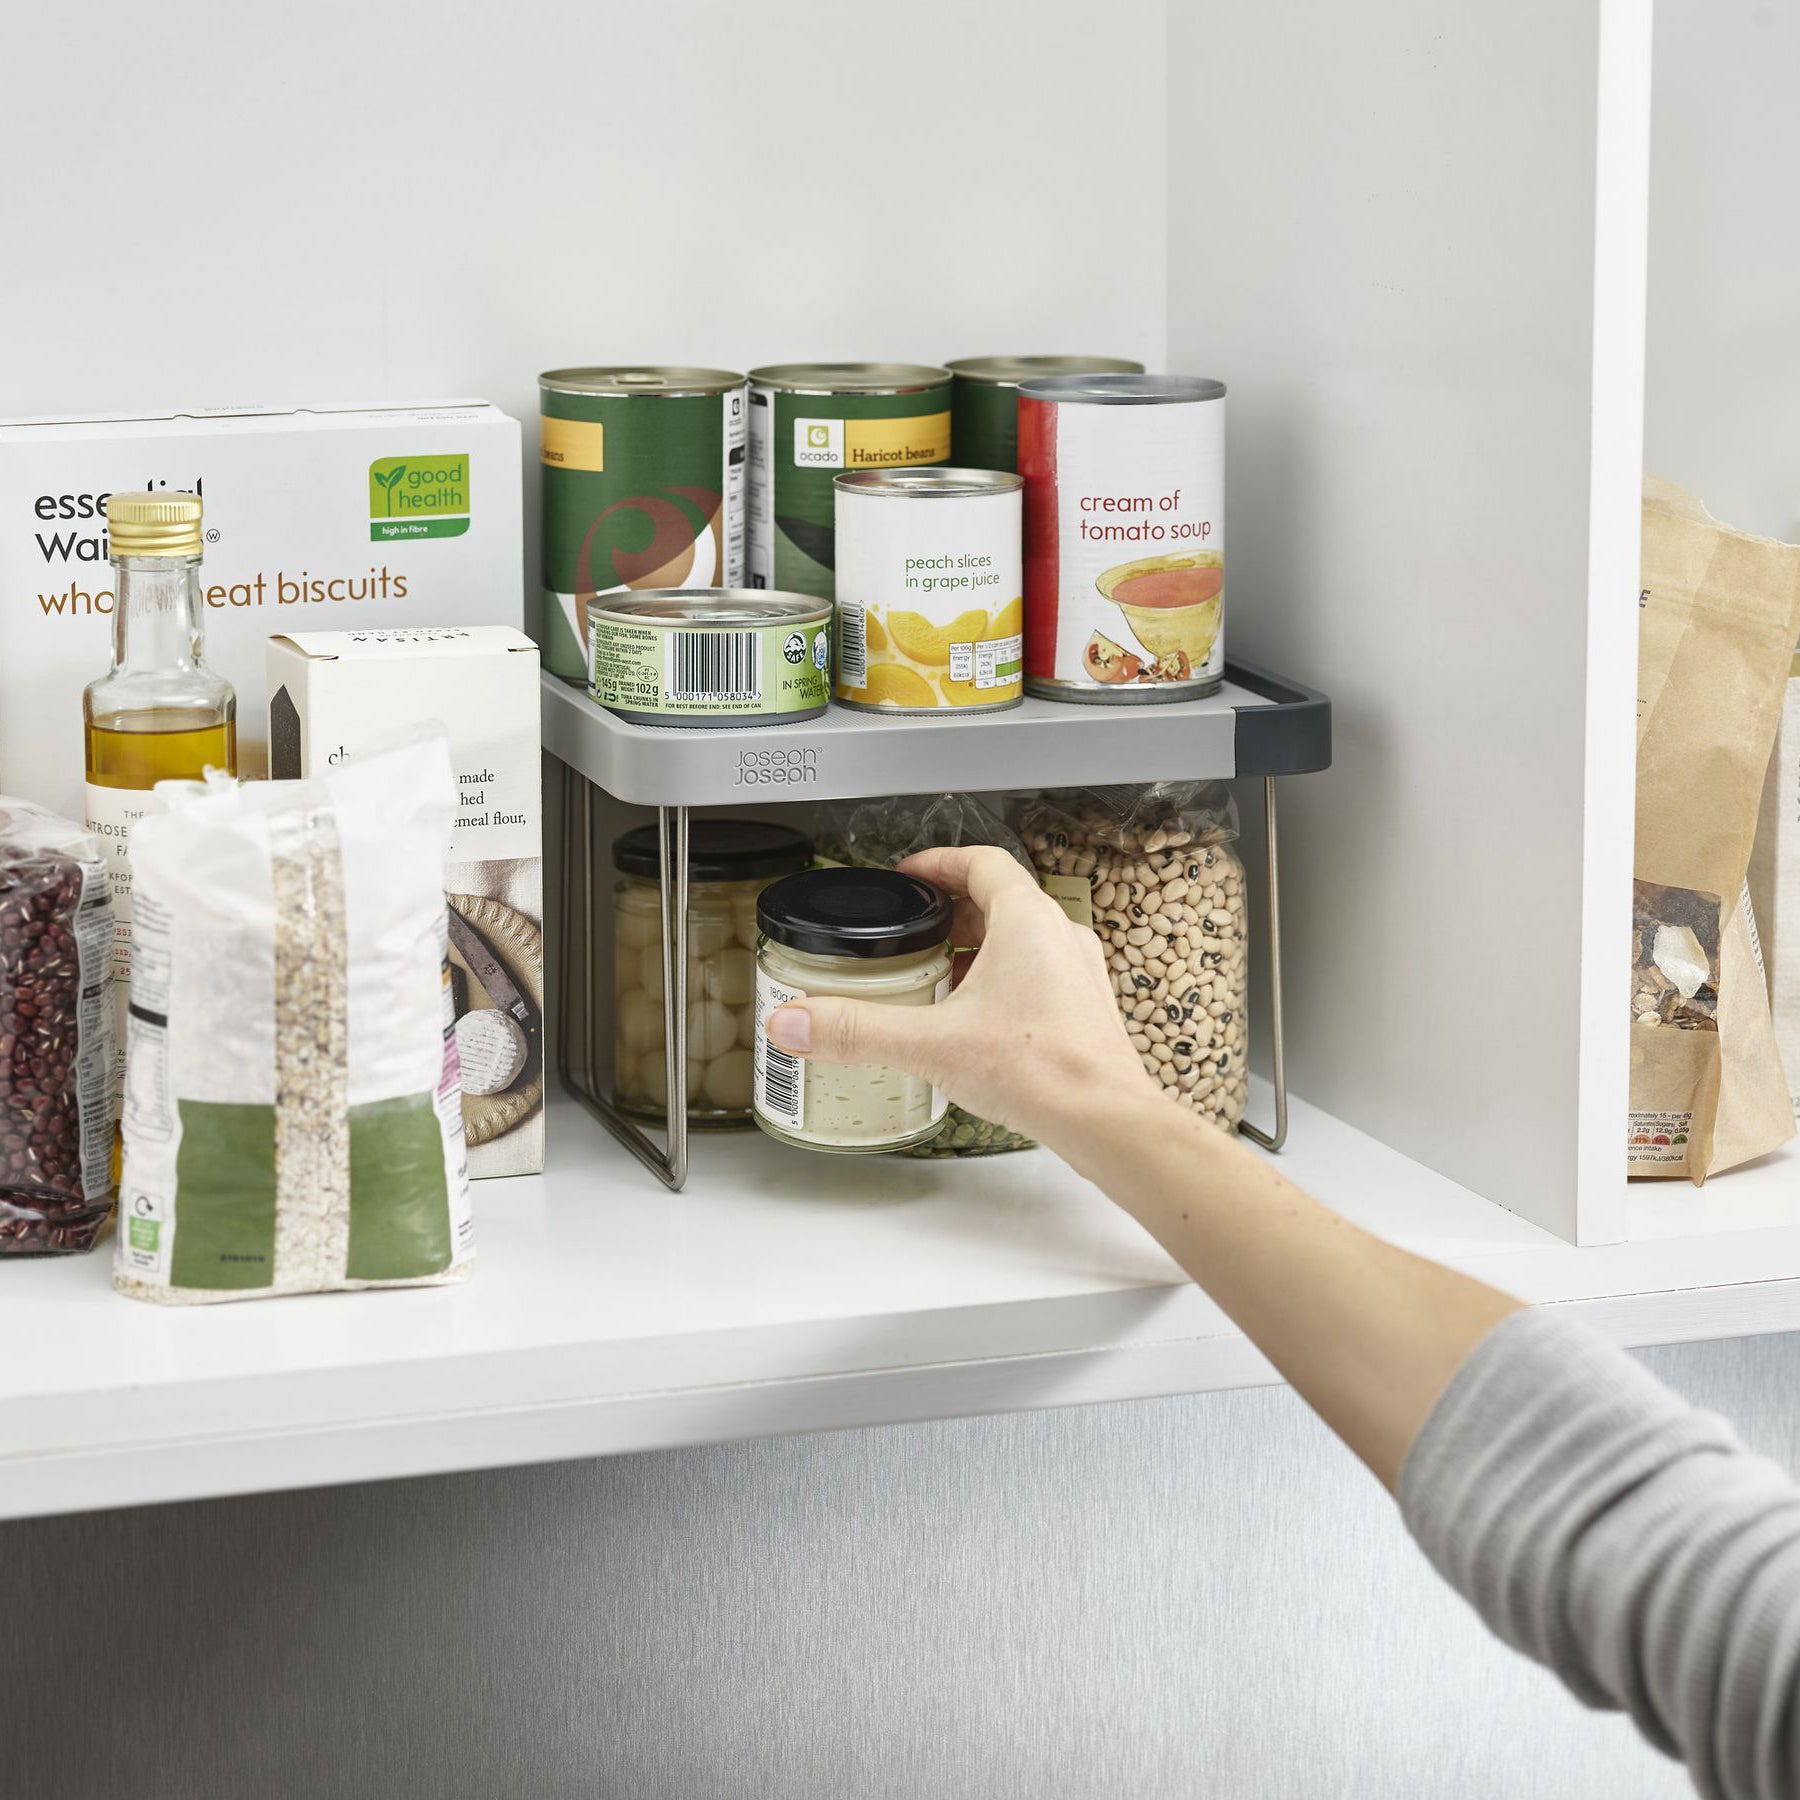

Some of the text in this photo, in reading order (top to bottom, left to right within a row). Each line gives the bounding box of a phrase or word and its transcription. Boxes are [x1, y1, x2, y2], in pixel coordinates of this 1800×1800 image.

[800, 451, 838, 463] ocado
[852, 446, 936, 463] Haricot beans
[408, 464, 463, 489] good
[398, 487, 463, 509] health
[1080, 490, 1181, 512] cream of
[382, 525, 428, 536] high in fibre
[1080, 519, 1212, 541] tomato soup
[905, 554, 992, 573] peach slices
[277, 566, 408, 605] biscuits
[905, 573, 1000, 592] in grape juice
[787, 650, 804, 662] SAFE
[664, 691, 753, 701] 5 000171 058034
[459, 769, 495, 784] made
[460, 791, 485, 806] hed
[493, 811, 527, 826] flour,
